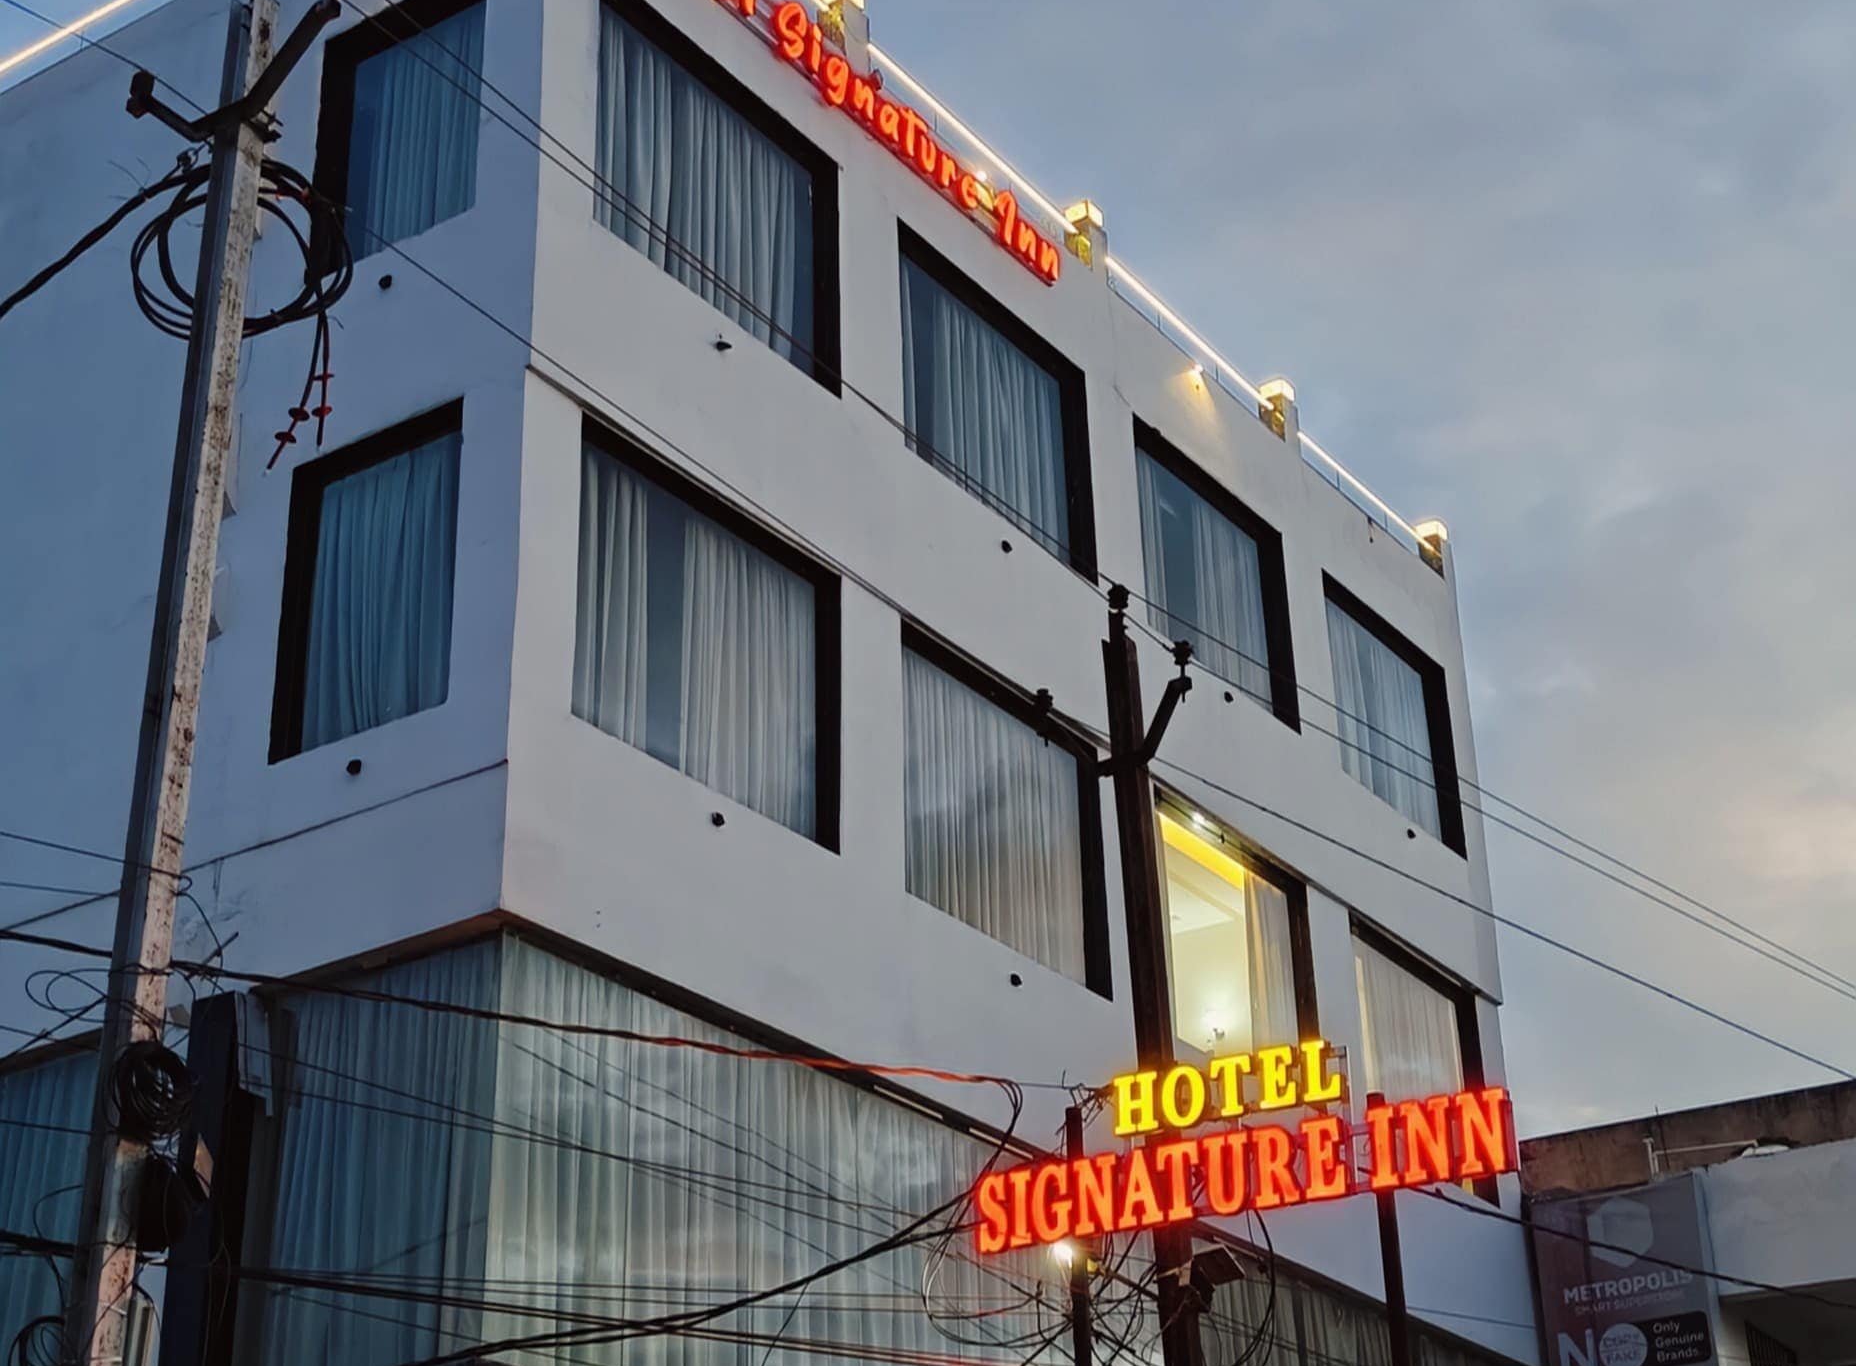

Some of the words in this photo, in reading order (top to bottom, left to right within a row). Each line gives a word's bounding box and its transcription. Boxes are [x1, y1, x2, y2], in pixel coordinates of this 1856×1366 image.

[772, 0, 981, 211] Signature
[994, 190, 1061, 283] Inn
[1113, 1038, 1342, 1136] HOTEL
[975, 1114, 1347, 1255] SIGNATURE
[1366, 1085, 1507, 1190] INN
[1563, 1268, 1694, 1305] METROPOLIS
[1652, 1320, 1681, 1335] Only
[1655, 1332, 1705, 1349] Genuine
[1656, 1346, 1700, 1363] Brands
